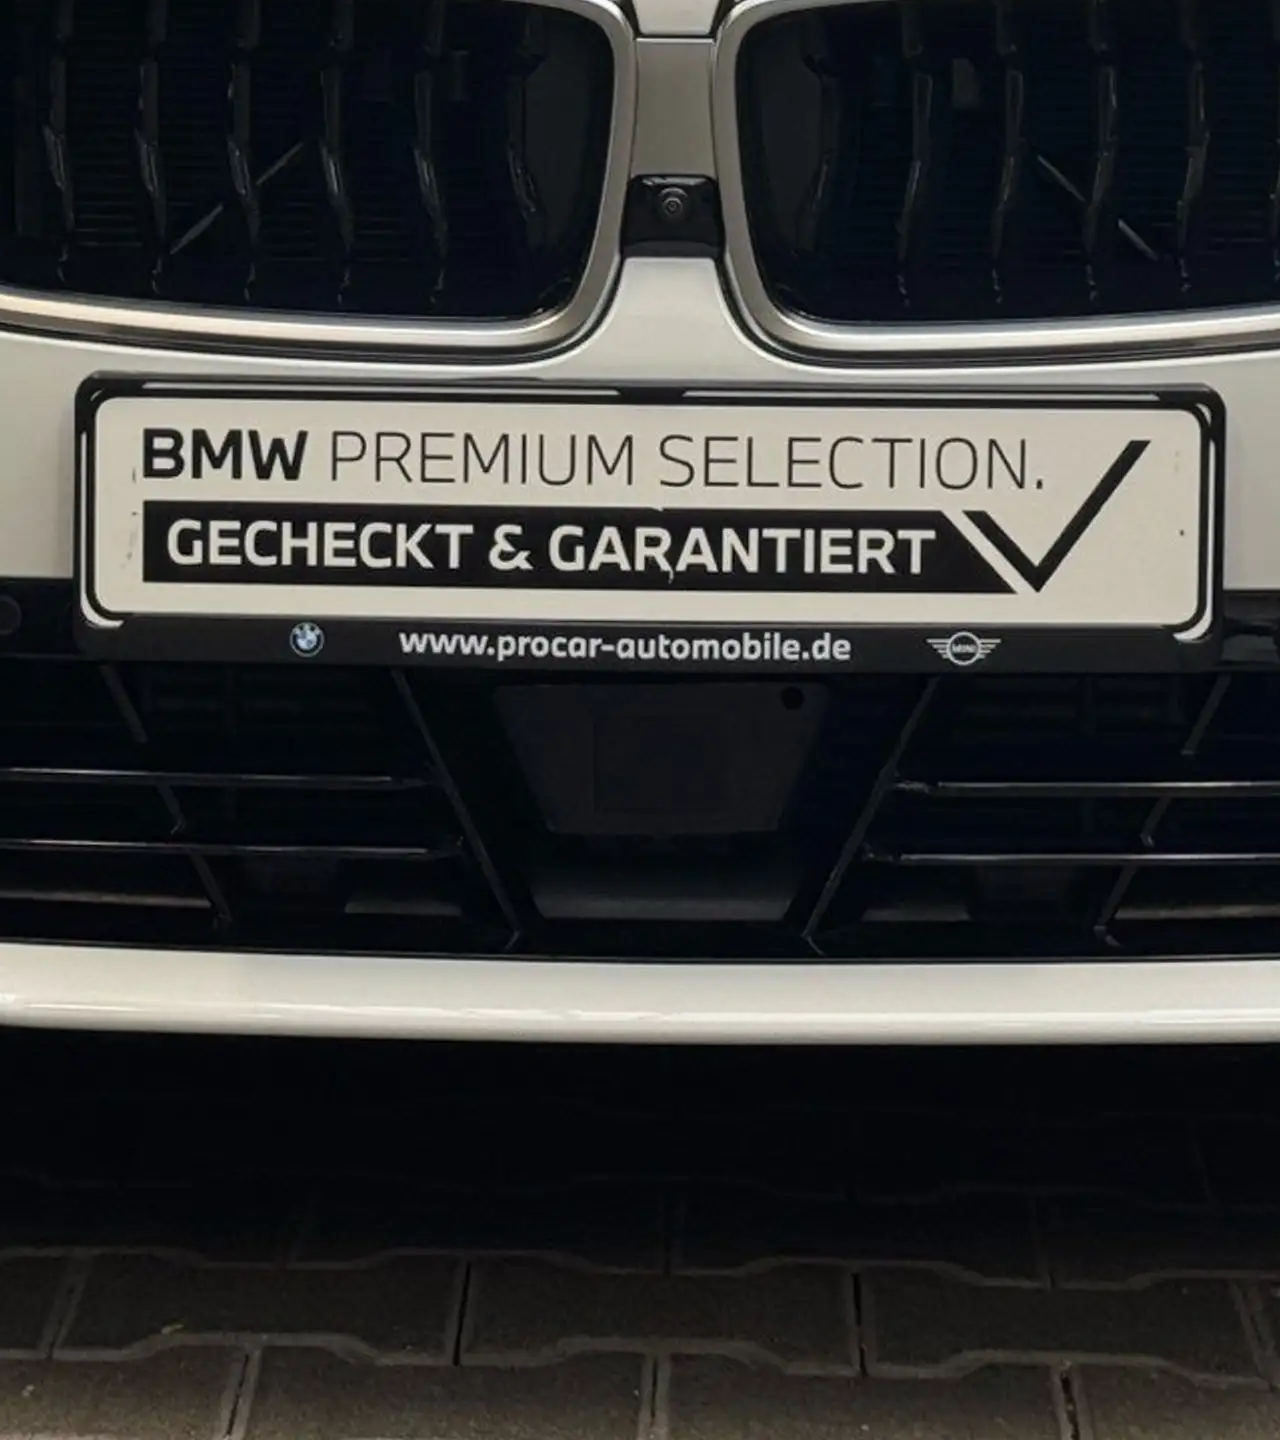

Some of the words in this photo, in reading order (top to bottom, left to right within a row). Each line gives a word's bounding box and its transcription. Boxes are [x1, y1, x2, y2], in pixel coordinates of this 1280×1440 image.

[142, 427, 309, 482] BMW
[330, 430, 635, 486] PREMIUM
[658, 434, 1045, 491] SELECTION.
[166, 518, 475, 571] GECHECKT
[488, 524, 534, 572] &
[548, 524, 937, 576] GARANTIERT
[398, 630, 852, 662] www.procar-automobile.de
